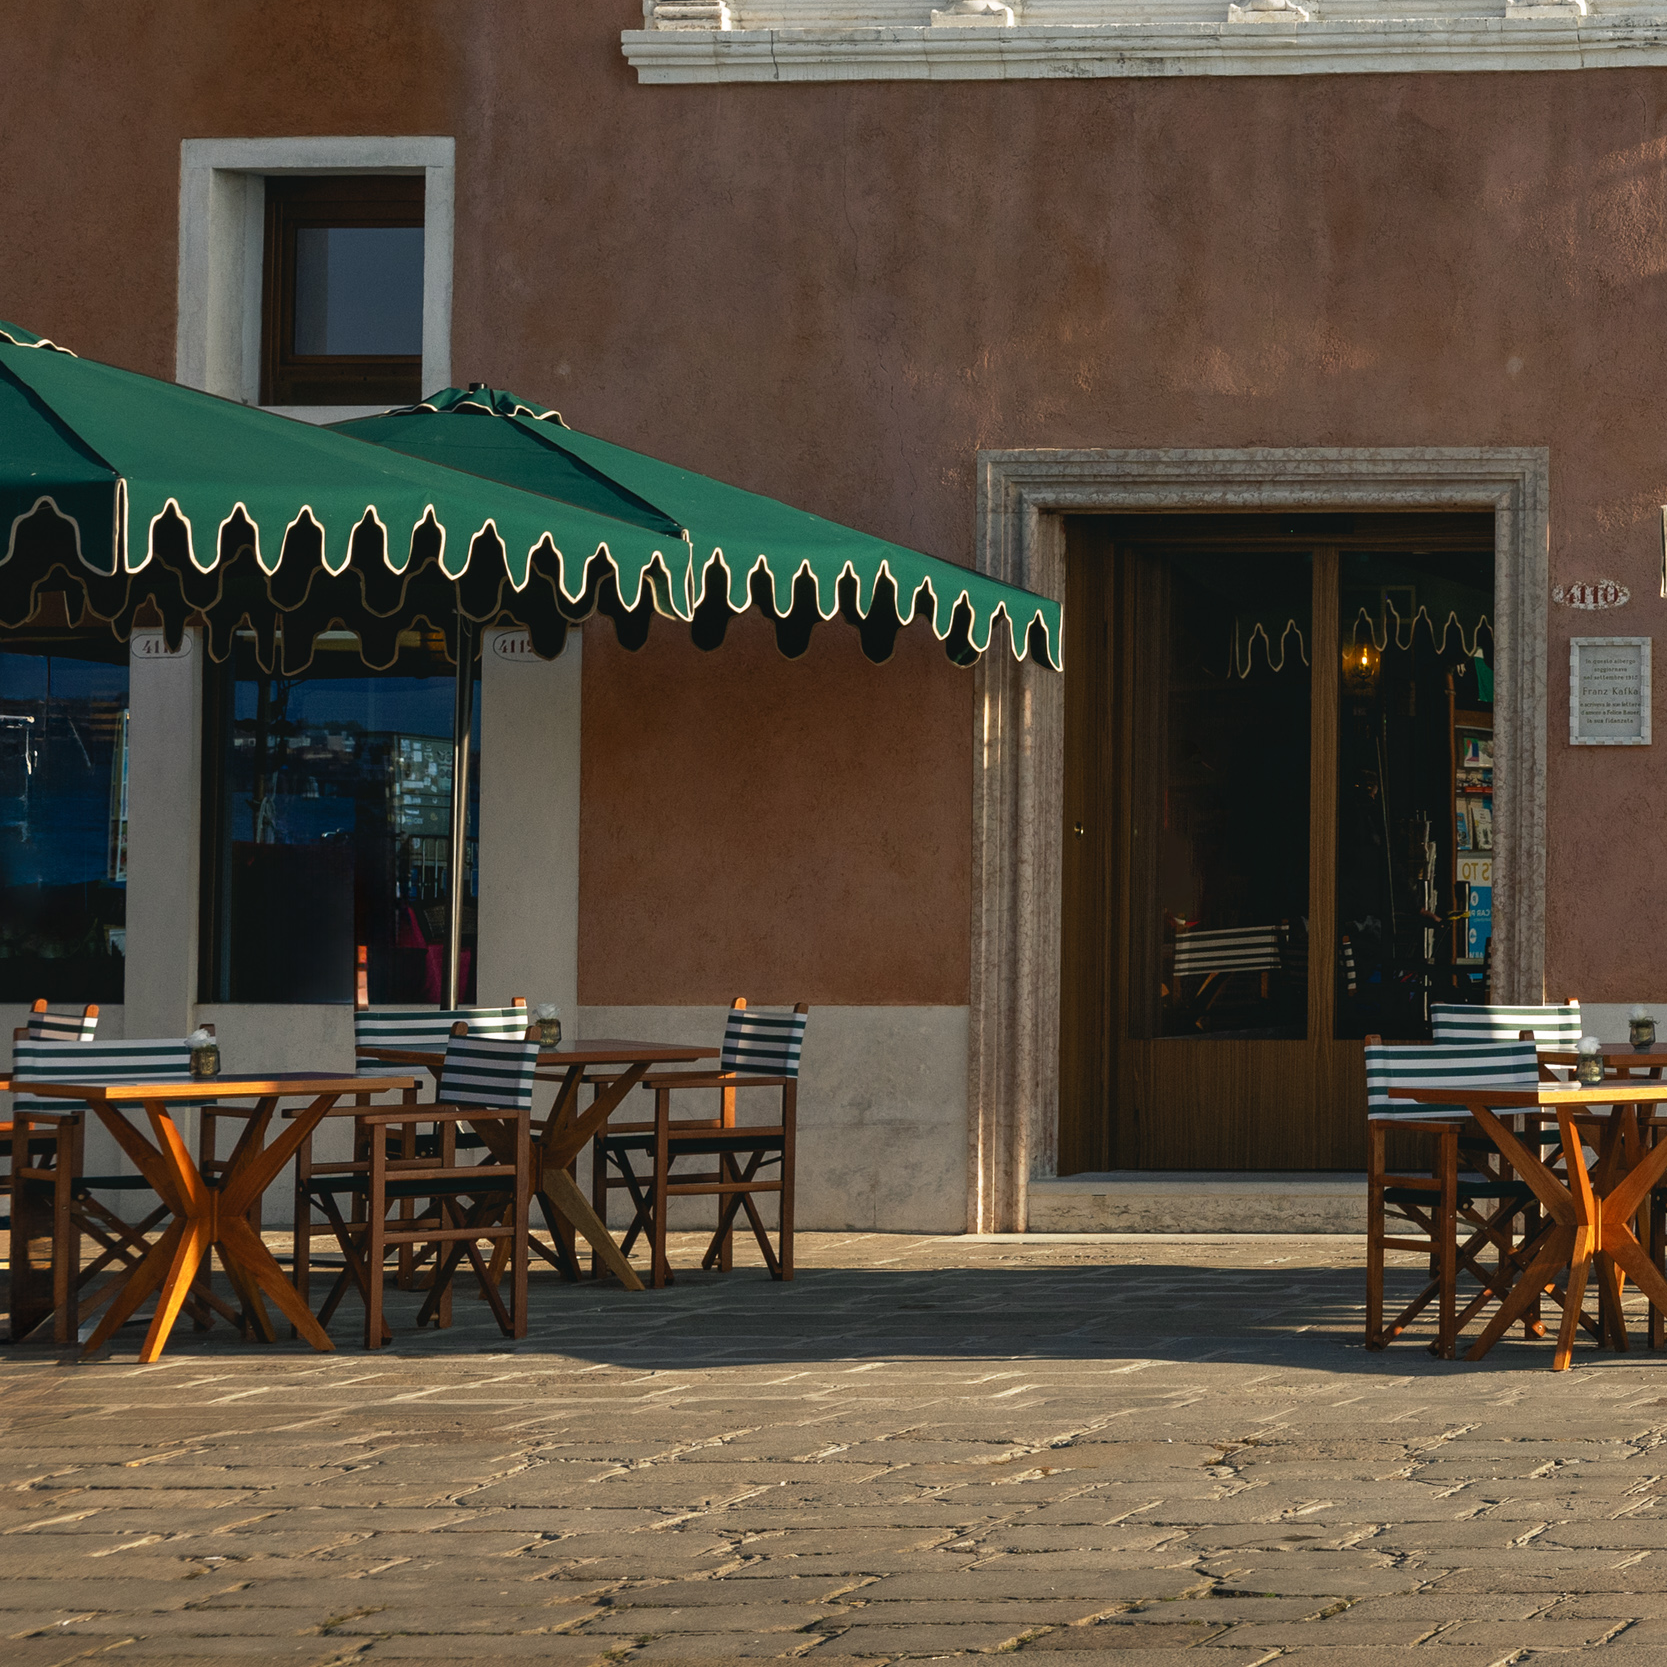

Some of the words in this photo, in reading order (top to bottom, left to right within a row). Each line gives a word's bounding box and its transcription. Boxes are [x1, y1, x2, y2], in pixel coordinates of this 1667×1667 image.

[1564, 585, 1619, 604] 4110
[1614, 658, 1637, 666] albergo
[1582, 686, 1608, 695] Franz
[1612, 686, 1639, 695] Kafka
